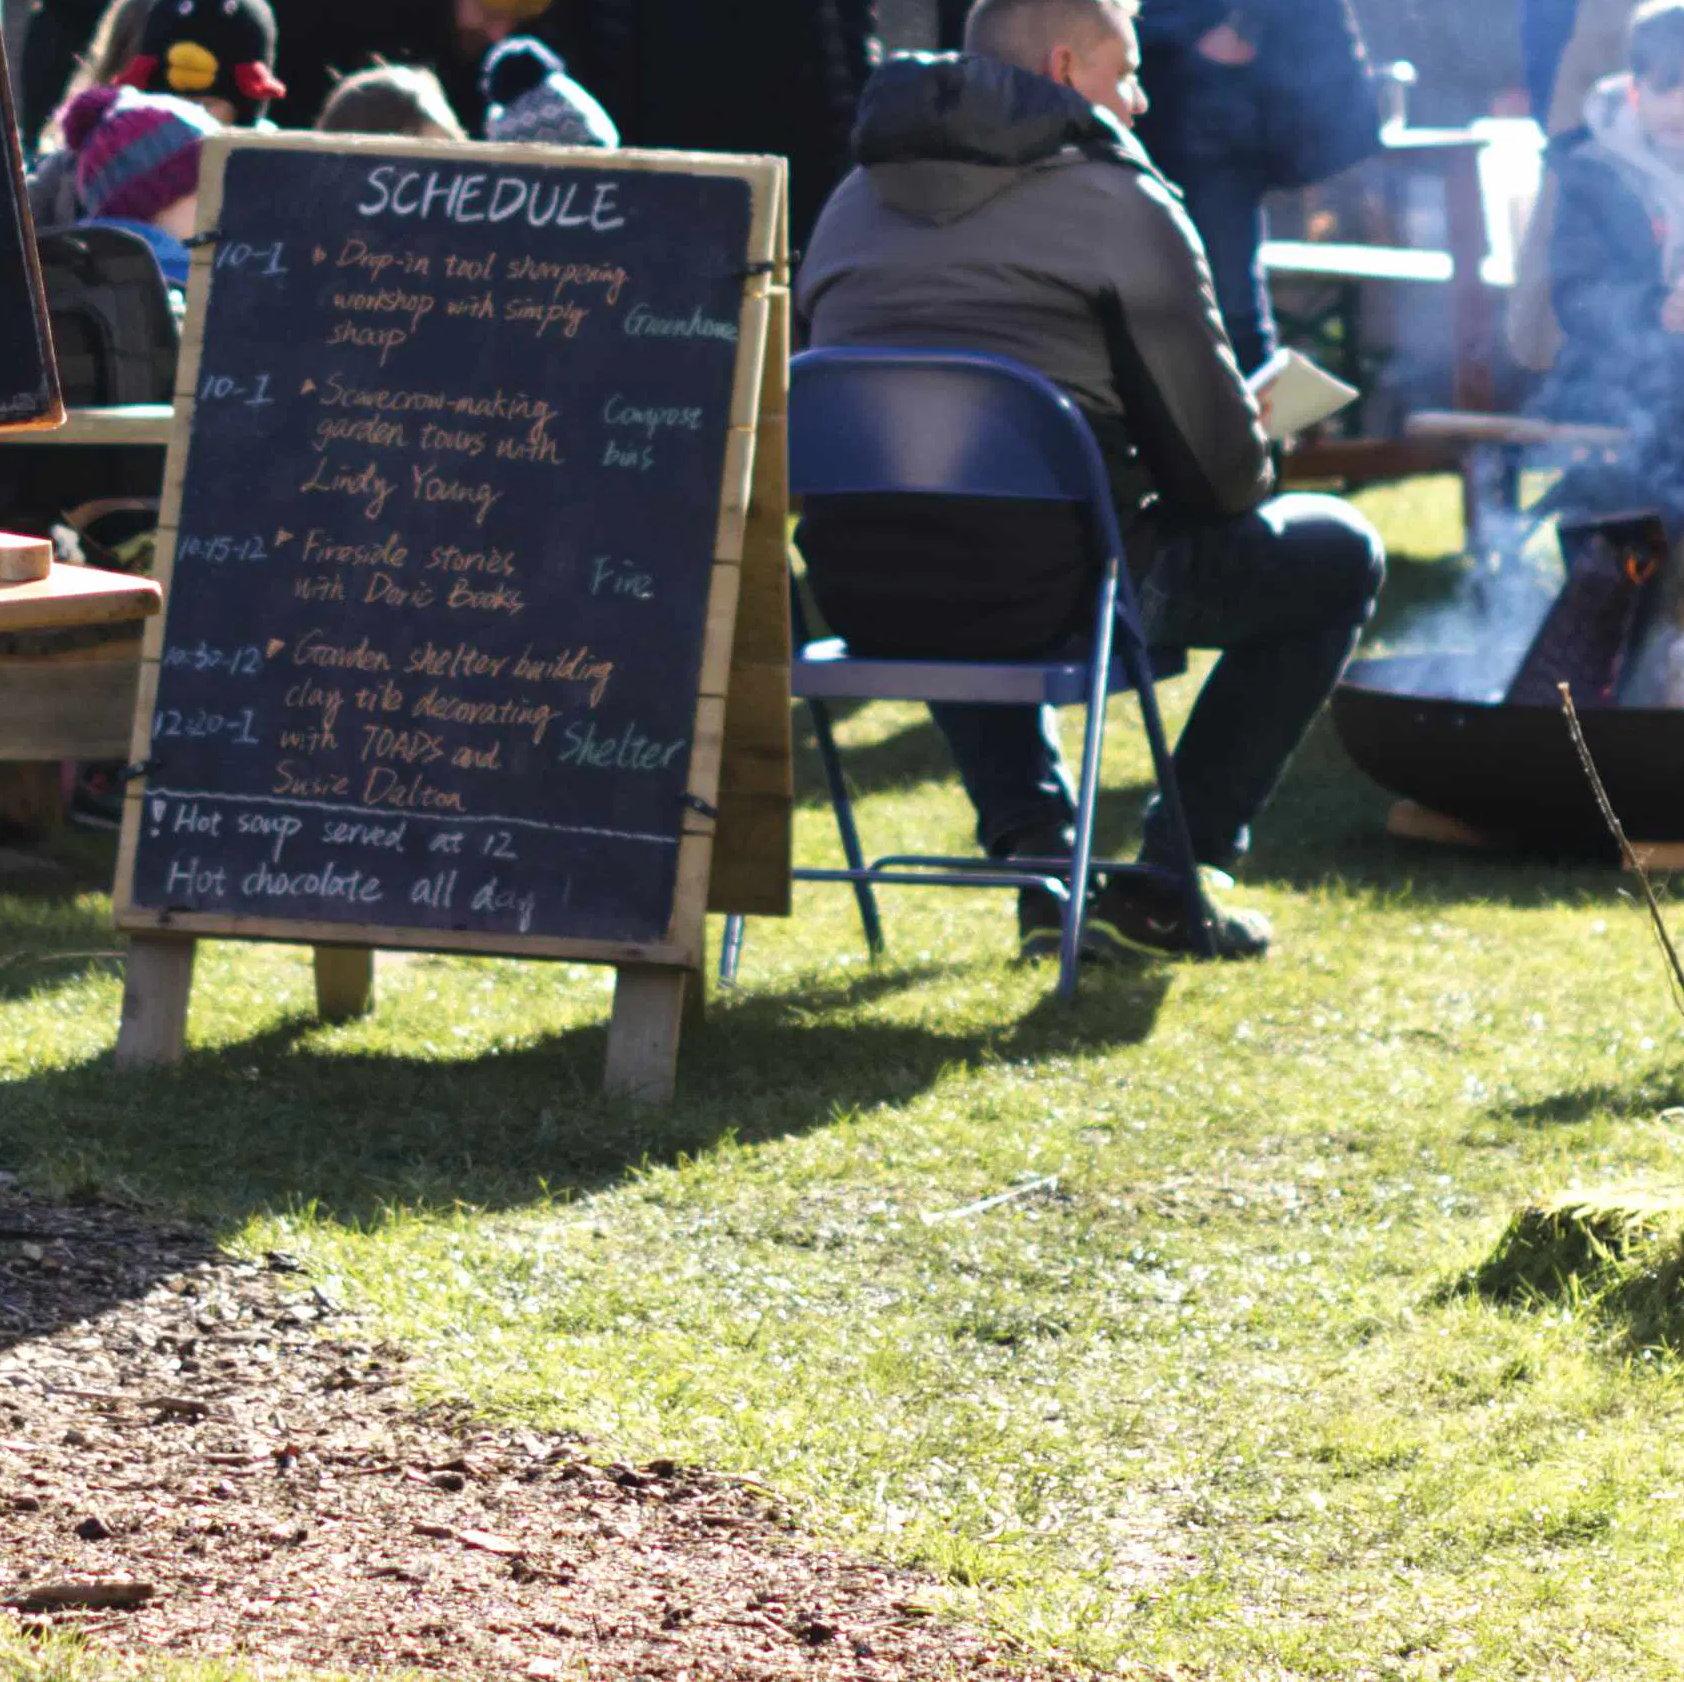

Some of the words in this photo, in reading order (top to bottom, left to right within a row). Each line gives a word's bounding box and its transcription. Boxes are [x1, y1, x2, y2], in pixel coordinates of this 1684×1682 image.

[357, 165, 626, 232] SCHEDULE
[216, 241, 290, 275] 10-1
[335, 237, 431, 284] Drop-in
[445, 253, 497, 282] tool
[505, 255, 629, 305] sharpening
[333, 286, 434, 334] workshop
[447, 292, 494, 319] with
[324, 320, 407, 368] sharp
[200, 373, 275, 407] 10-1
[318, 370, 560, 445] Scarecrow-making
[312, 413, 409, 452] garden
[422, 423, 486, 457] tours
[494, 435, 565, 464] with
[601, 439, 655, 471] bins
[298, 456, 399, 520] Lindy
[411, 463, 504, 526] Young
[301, 529, 409, 568] Fireside
[425, 545, 516, 576] stories
[591, 554, 655, 600] Fire
[294, 573, 344, 602] with
[362, 571, 437, 609] Doric
[446, 576, 531, 615] Books
[292, 628, 392, 670] Garden
[402, 641, 511, 679] shelter
[511, 643, 615, 708] building
[284, 677, 345, 729] clay
[354, 679, 404, 712] tile
[411, 684, 563, 746] decorating
[279, 724, 338, 755] with
[361, 723, 445, 764] TOADS
[451, 739, 503, 768] and
[557, 719, 687, 772] Shelter
[271, 758, 351, 797] Susie
[362, 765, 467, 812] Dalton
[173, 802, 224, 838] Hot
[237, 814, 303, 864] soup
[321, 820, 404, 854] served
[428, 831, 465, 855] at
[483, 829, 518, 860] 12
[166, 855, 227, 898] Hot
[241, 861, 384, 902] chocolate
[410, 869, 459, 910] all
[470, 876, 536, 934] day
